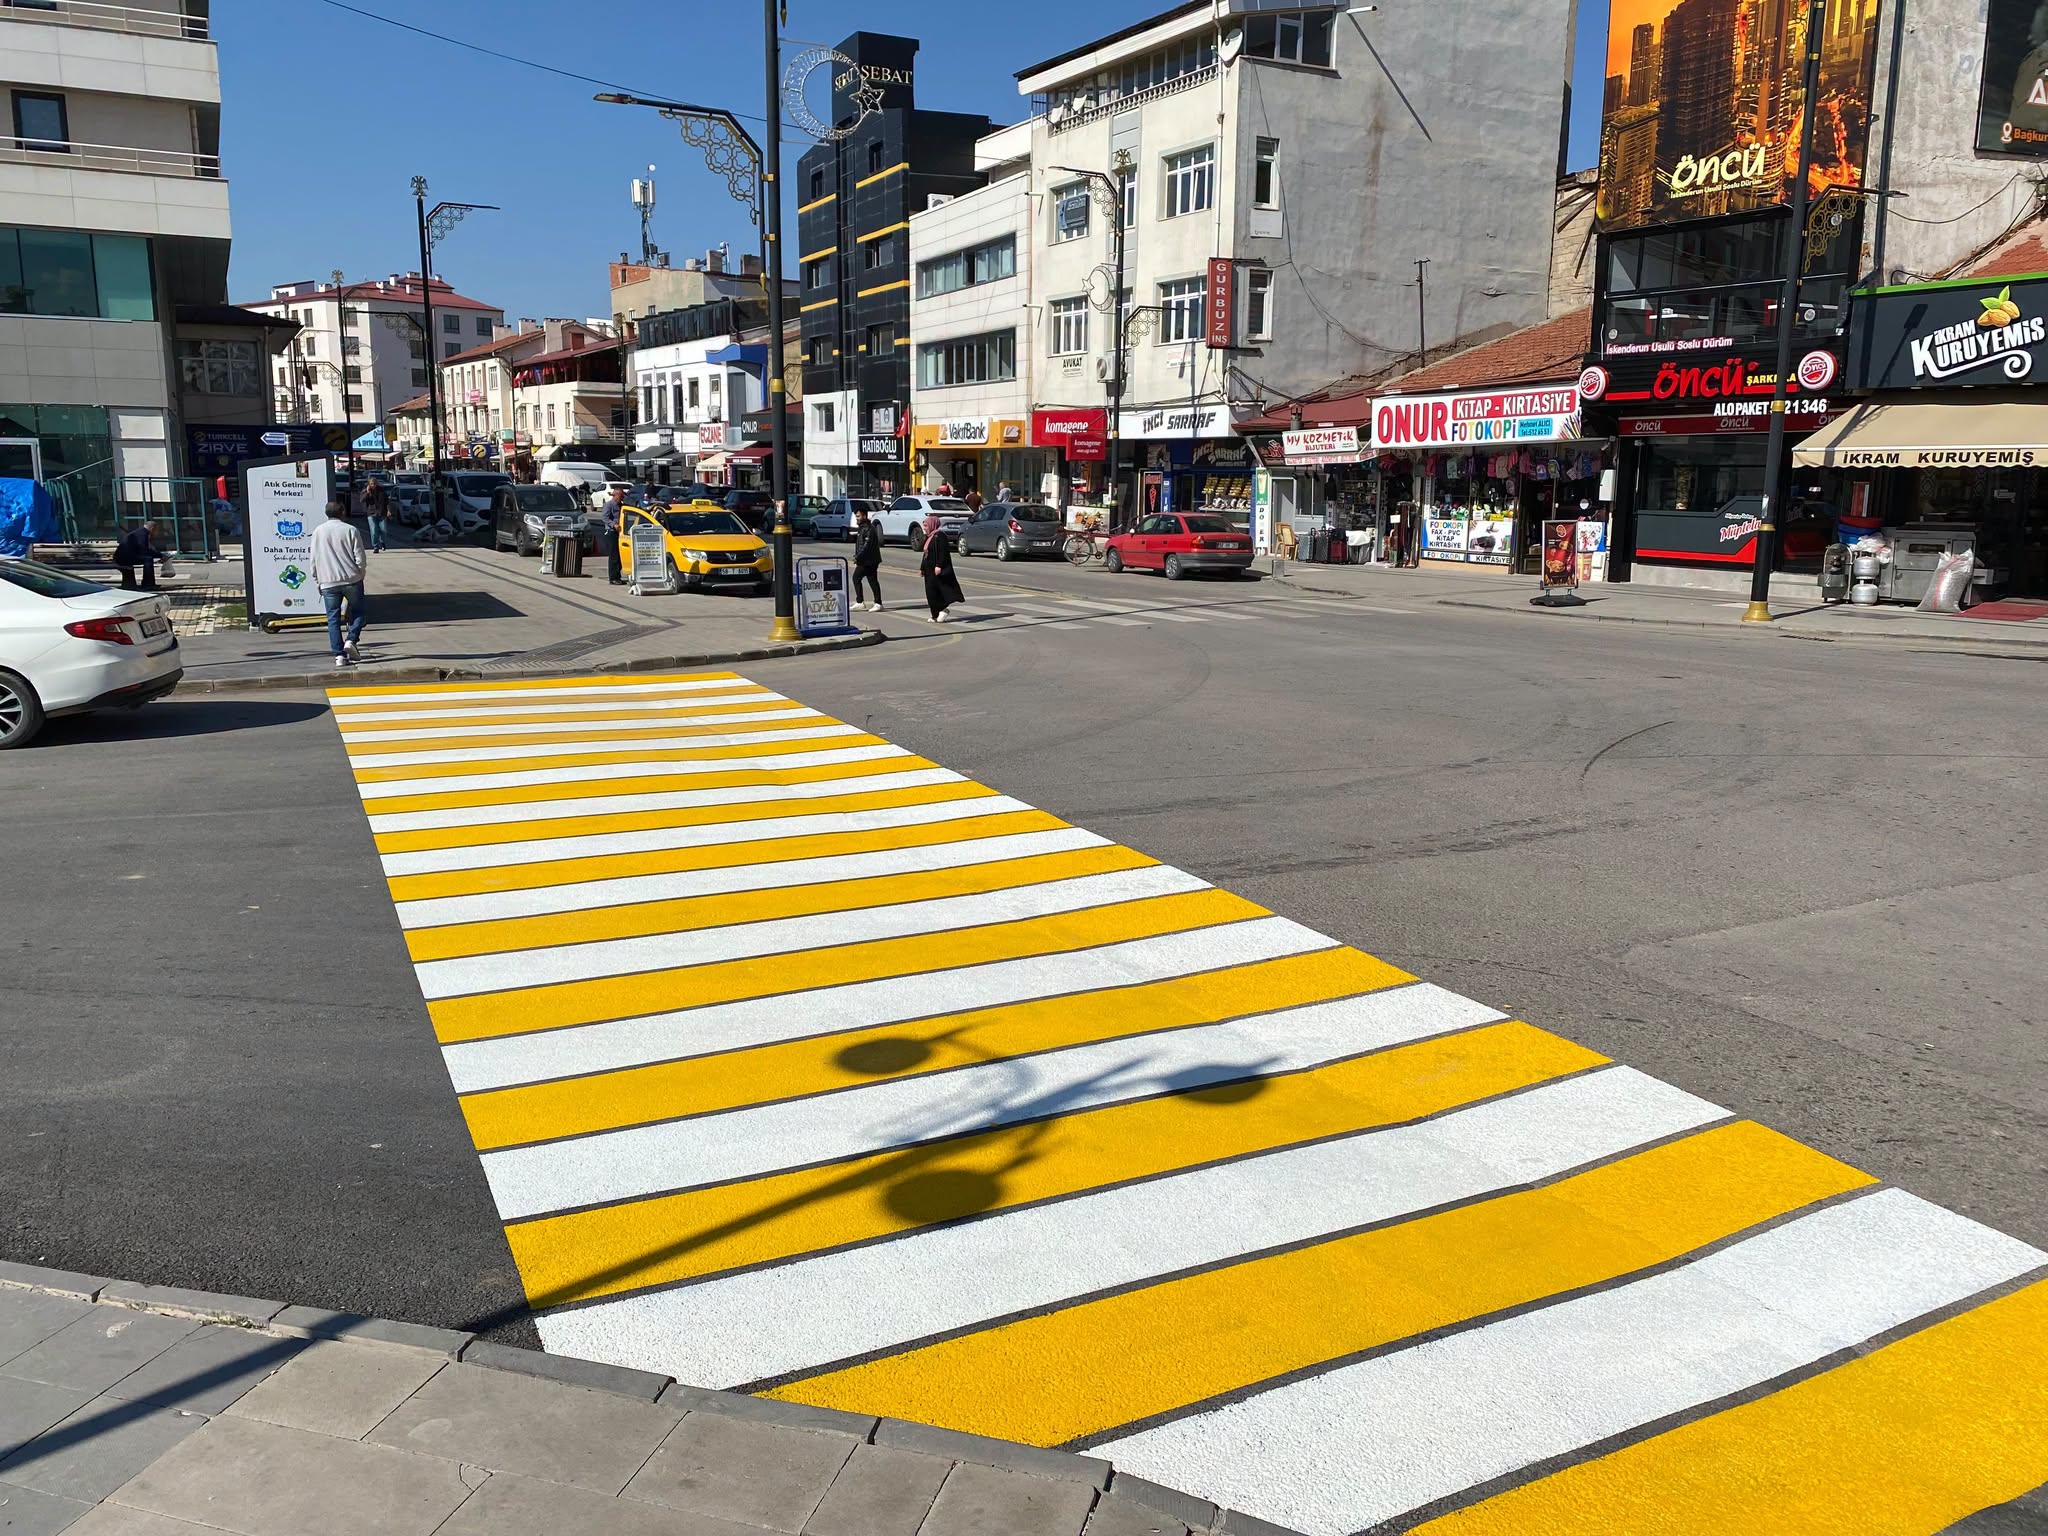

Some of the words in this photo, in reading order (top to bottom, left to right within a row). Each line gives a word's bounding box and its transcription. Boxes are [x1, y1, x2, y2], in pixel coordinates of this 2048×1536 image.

[860, 64, 913, 85] SEBAT
[1723, 182, 1740, 190] Soslu
[1740, 179, 1762, 188] Dürüm
[1606, 343, 1649, 355] İskenderun
[1651, 341, 1675, 352] Usulü
[1677, 339, 1701, 350] Soslu
[1702, 337, 1733, 349] Dürüm
[1062, 357, 1083, 368] AVUKAT
[1746, 373, 1797, 386] ŞARKIA
[1735, 401, 1770, 416] PAKET
[741, 421, 758, 434] ONUR
[1045, 418, 1089, 434] komagene
[1167, 412, 1217, 430] SARRAF
[1378, 402, 1448, 444] ONUR
[700, 425, 722, 444] ECZANE
[1287, 435, 1300, 447] MY
[862, 436, 897, 453] HATİBOĞLU
[1843, 451, 1900, 464] İKRAM
[1917, 449, 2034, 466] KURUYEMİŞ
[281, 481, 312, 489] Getirme
[1720, 518, 1762, 542] Müptela
